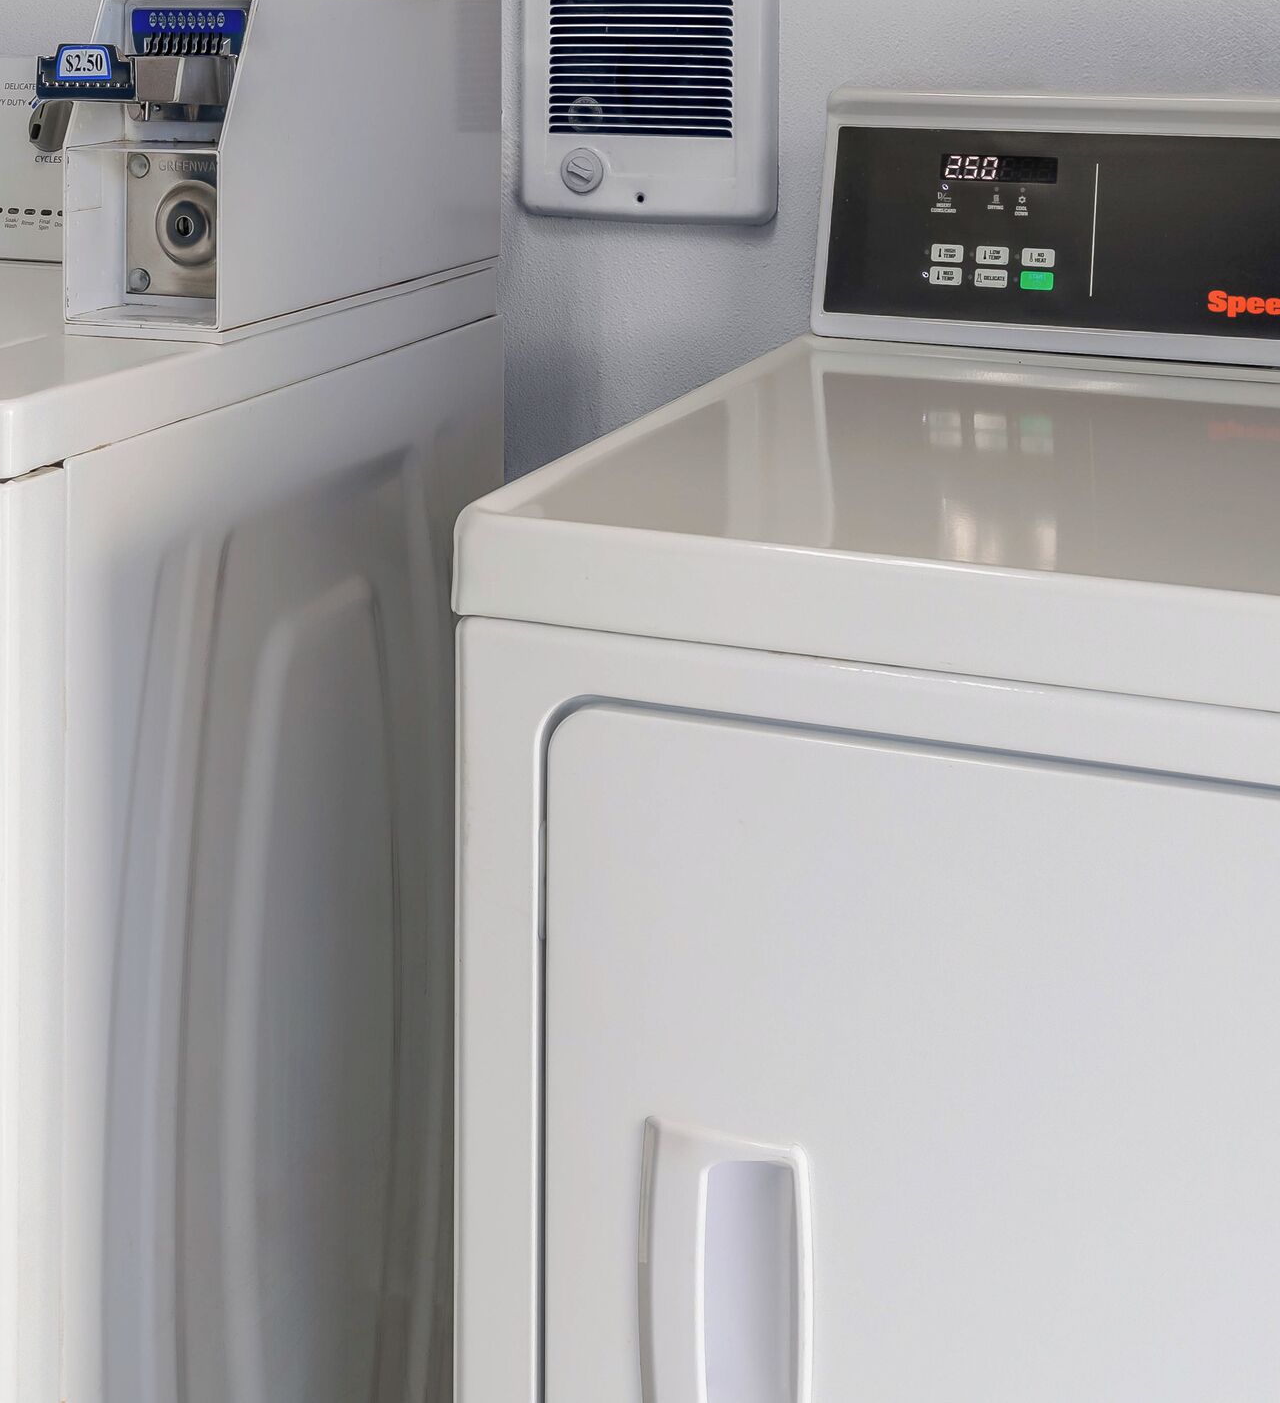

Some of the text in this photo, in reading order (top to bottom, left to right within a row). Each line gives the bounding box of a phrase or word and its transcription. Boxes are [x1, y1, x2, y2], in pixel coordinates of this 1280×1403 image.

[65, 53, 103, 73] $2.50
[4, 82, 36, 91] DELICATE
[35, 155, 62, 163] CYCLES
[158, 160, 216, 172] GREENWA
[944, 155, 999, 180] 2.50
